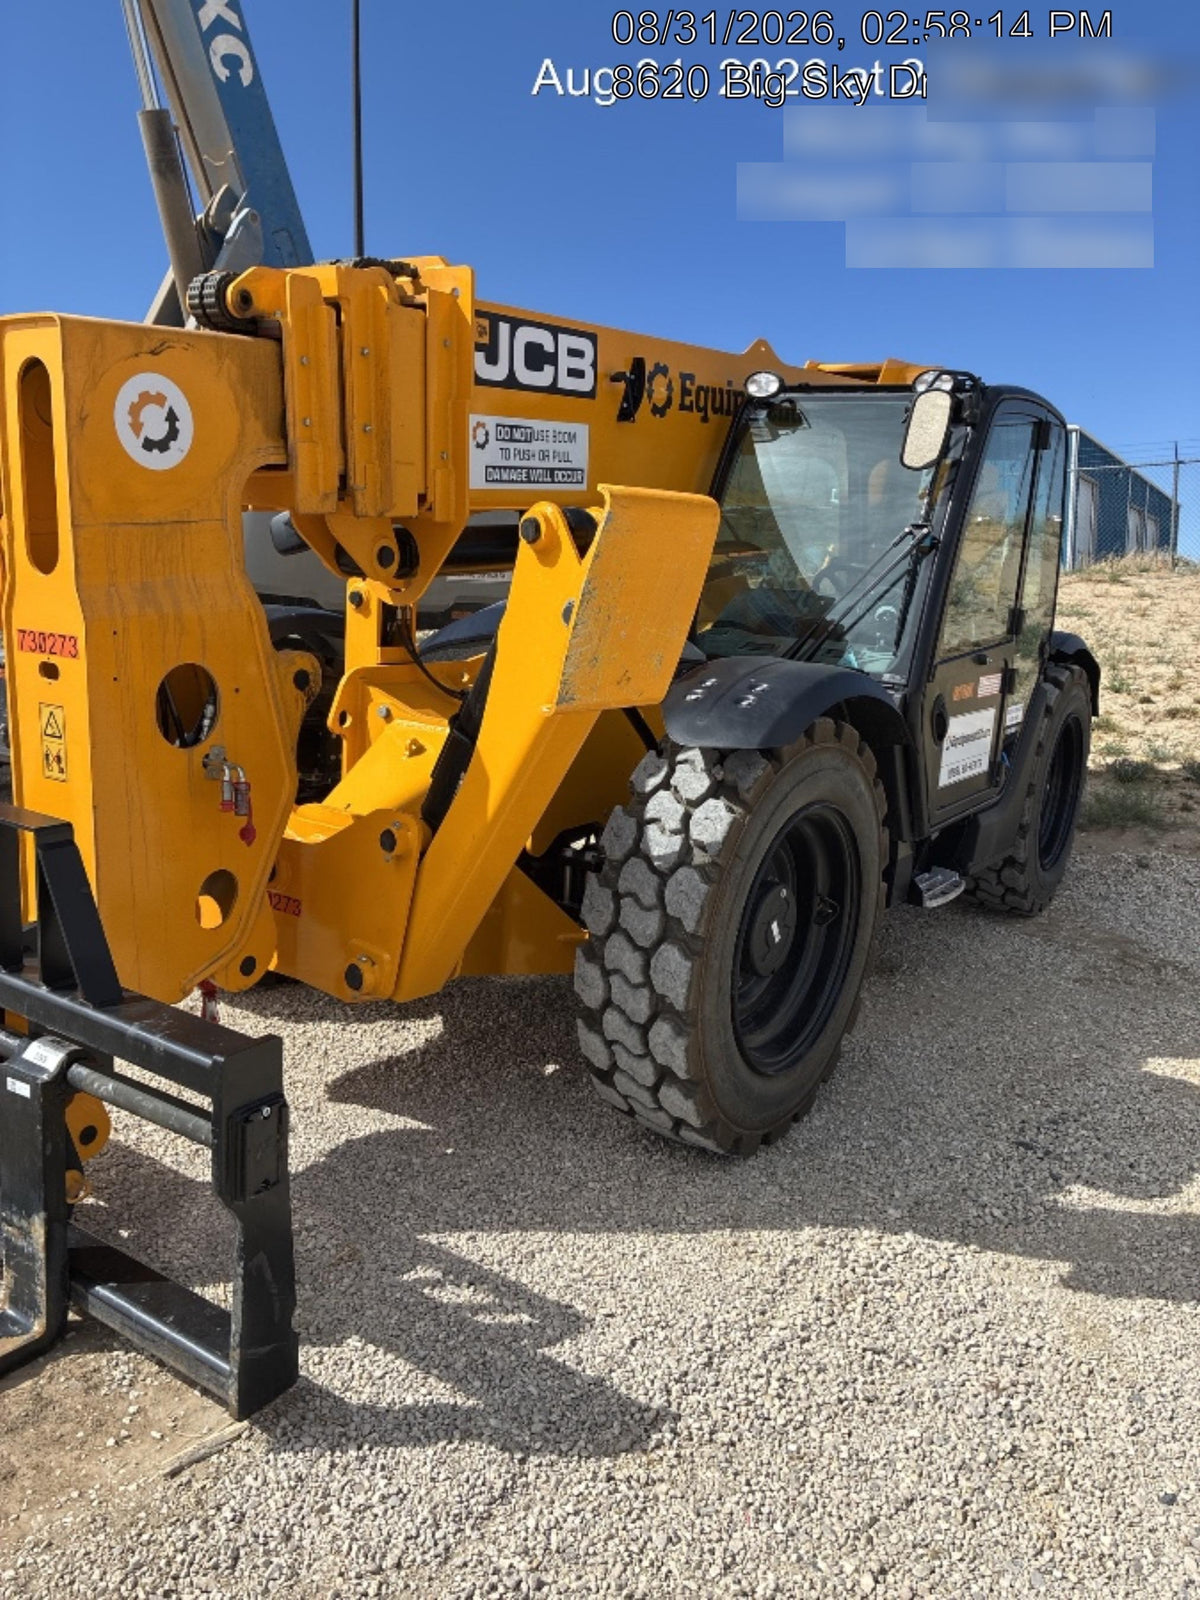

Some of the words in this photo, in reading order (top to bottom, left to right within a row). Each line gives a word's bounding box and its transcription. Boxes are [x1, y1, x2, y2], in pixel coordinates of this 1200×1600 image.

[474, 321, 595, 392] JCB
[497, 426, 510, 440] DO
[511, 427, 532, 442] NOT
[533, 429, 550, 443] USE
[552, 430, 577, 444] BOOM
[499, 447, 511, 461] TO
[538, 450, 550, 463] OR
[552, 450, 573, 463] PULL
[487, 467, 529, 482] DAMAGE
[529, 469, 553, 483] WILL
[554, 469, 583, 484] OCCUR
[17, 628, 79, 659] 730273
